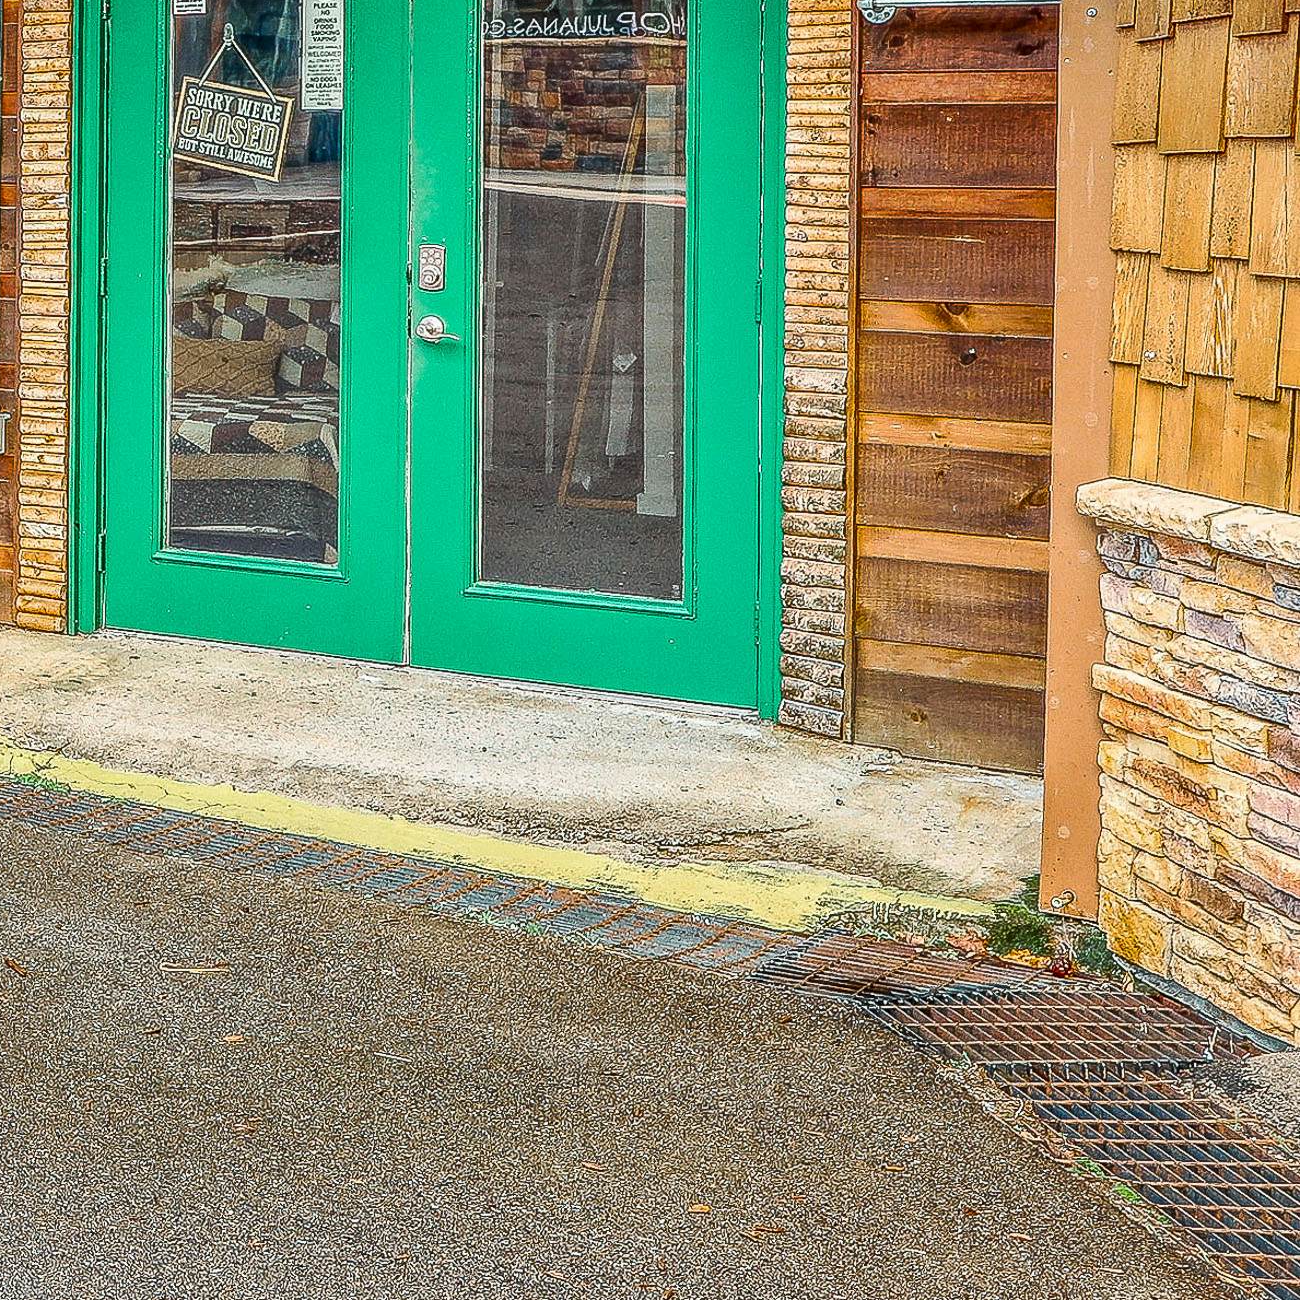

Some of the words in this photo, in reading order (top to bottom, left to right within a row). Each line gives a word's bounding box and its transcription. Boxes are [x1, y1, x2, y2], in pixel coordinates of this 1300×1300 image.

[186, 87, 235, 113] SORRY
[180, 105, 280, 156] CLOSED
[177, 136, 199, 152] BUT
[199, 141, 227, 159] STILL
[226, 148, 275, 170] AWESOME
